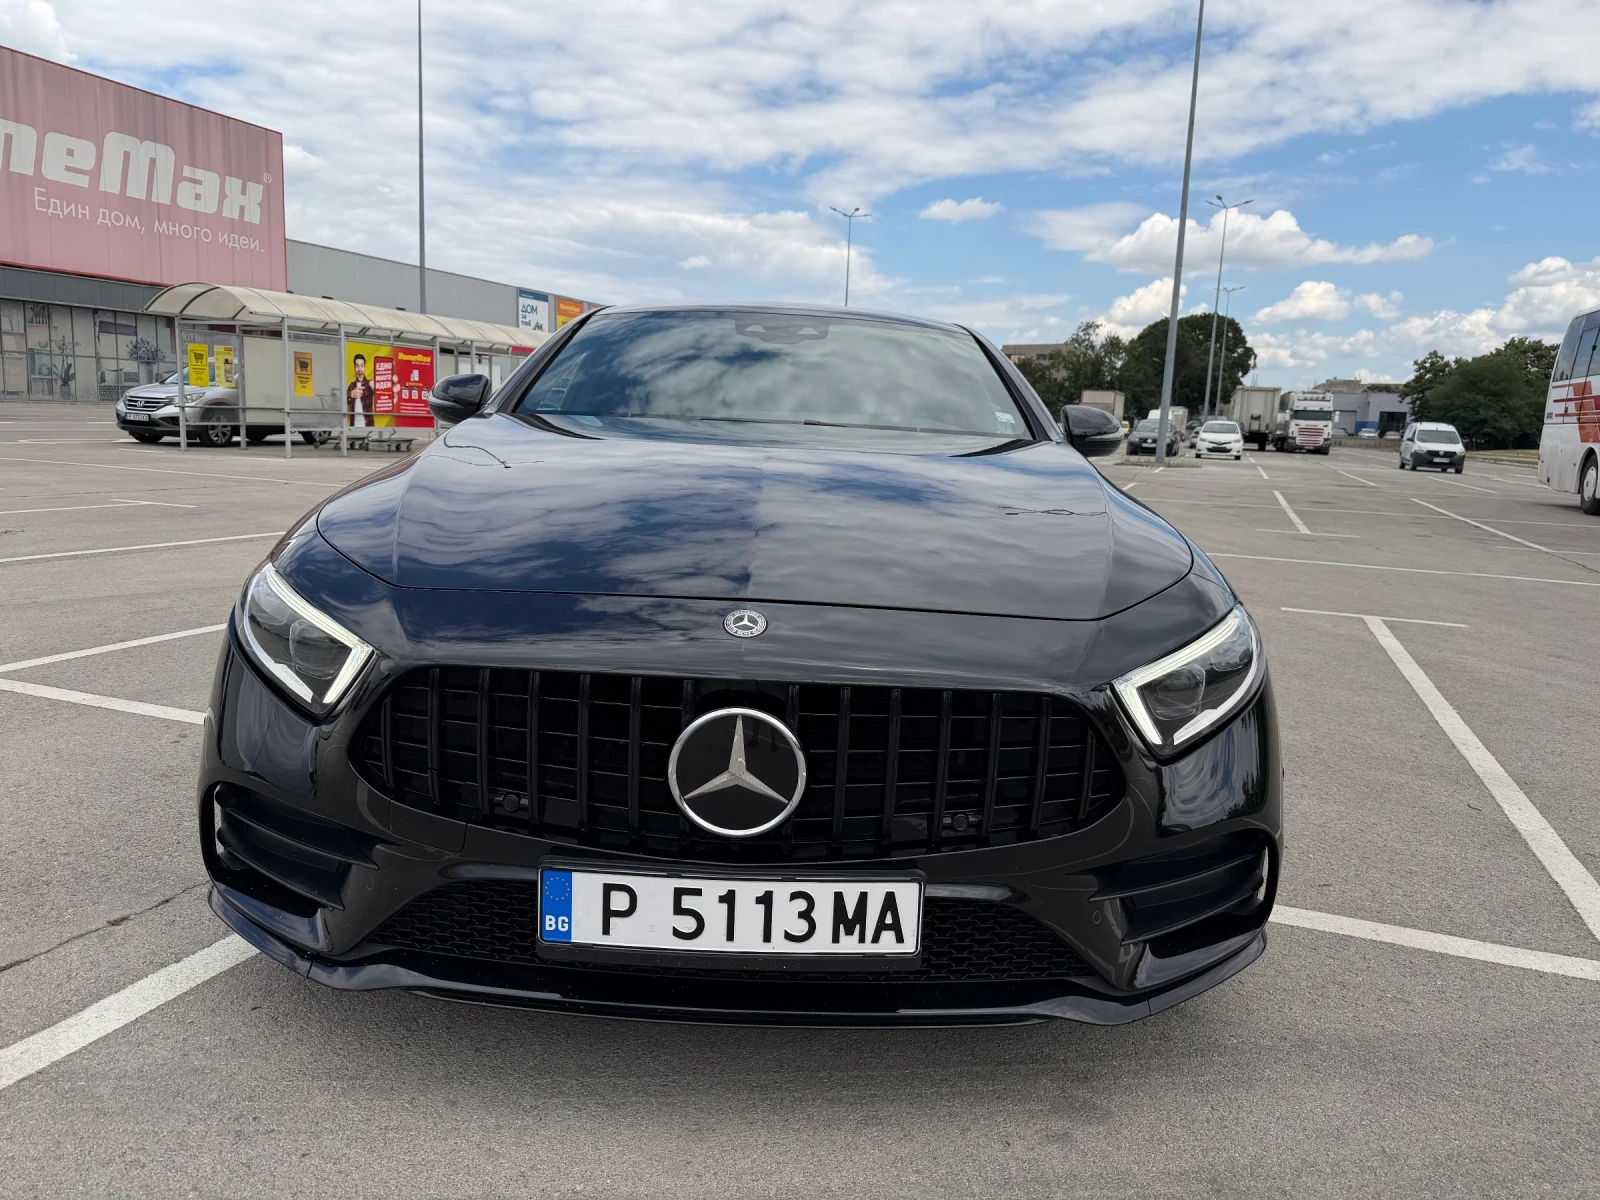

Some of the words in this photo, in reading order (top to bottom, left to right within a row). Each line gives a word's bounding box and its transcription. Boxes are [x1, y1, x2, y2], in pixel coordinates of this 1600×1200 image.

[33, 186, 90, 220] Един
[97, 207, 146, 235] дом,
[153, 219, 213, 242] много
[218, 231, 265, 252] идеи.
[545, 914, 569, 932] BG
[601, 882, 638, 936] P
